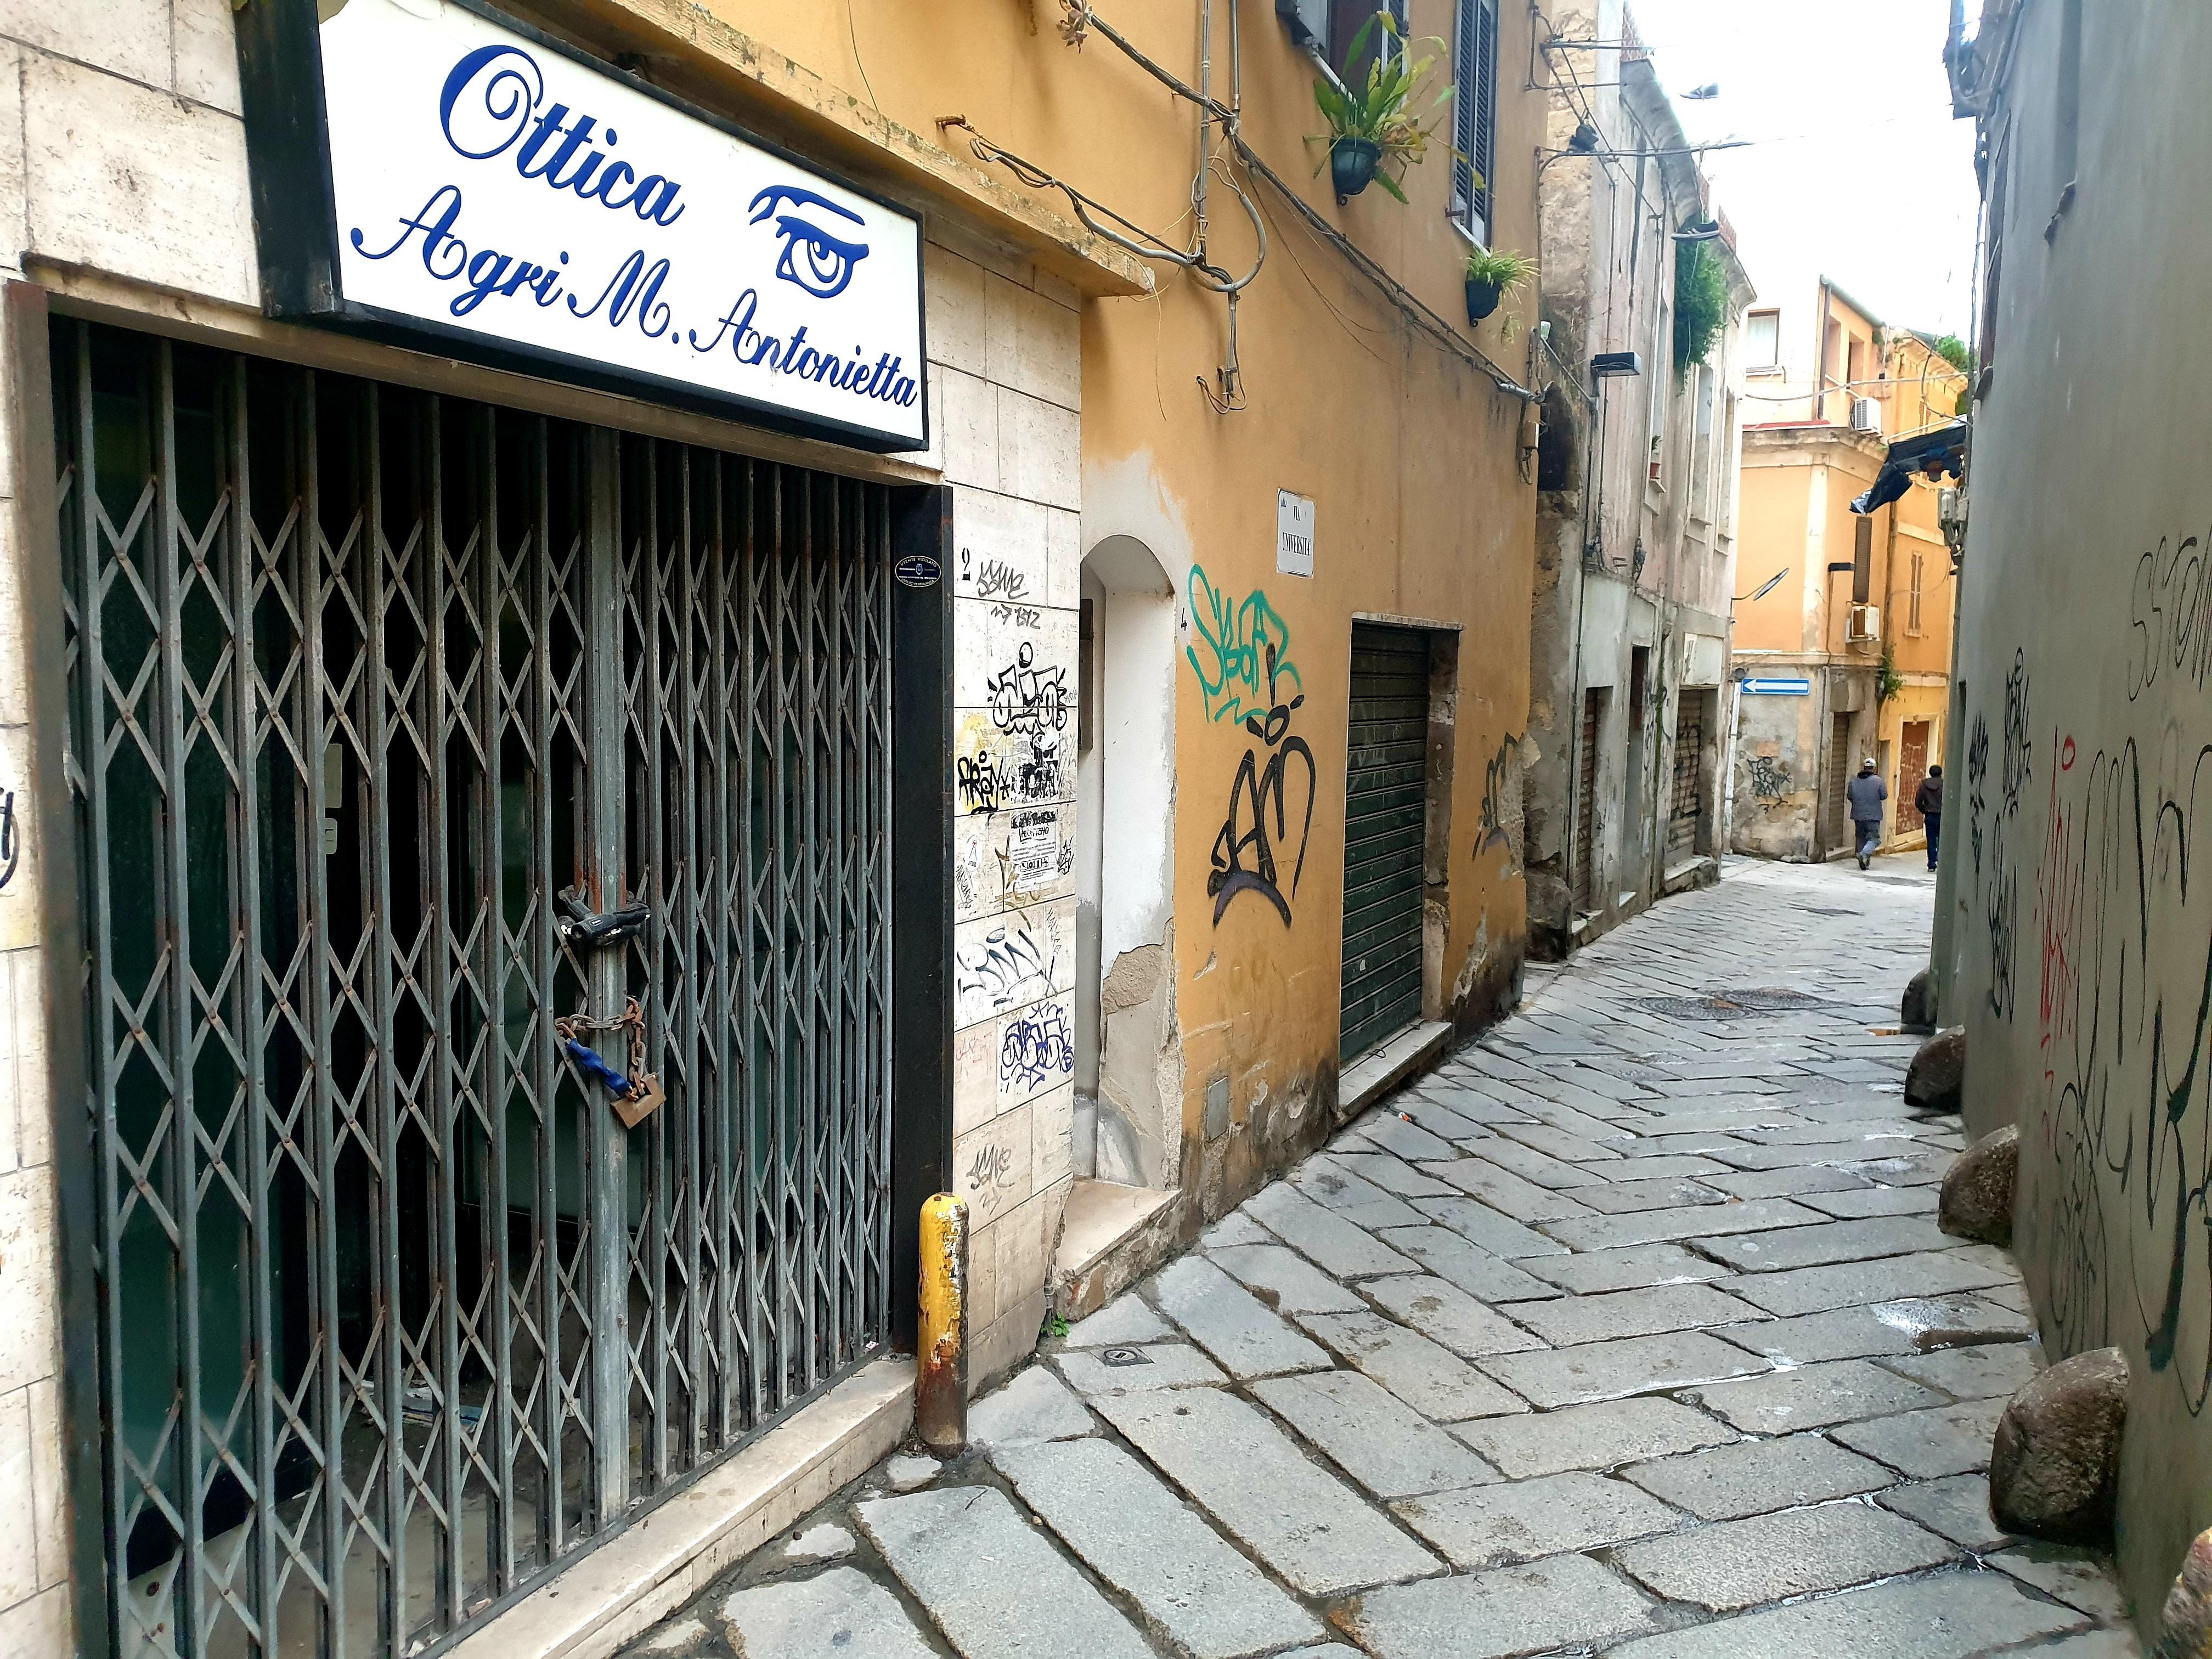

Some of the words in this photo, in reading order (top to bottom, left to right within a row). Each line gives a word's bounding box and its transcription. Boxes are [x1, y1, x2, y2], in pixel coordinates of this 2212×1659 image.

[439, 44, 685, 227] Ottica
[351, 185, 568, 317] Agri
[567, 250, 679, 344] M.
[689, 288, 918, 408] Antonietta
[900, 557, 916, 566] UTENTE
[917, 557, 937, 567] VIGILATO
